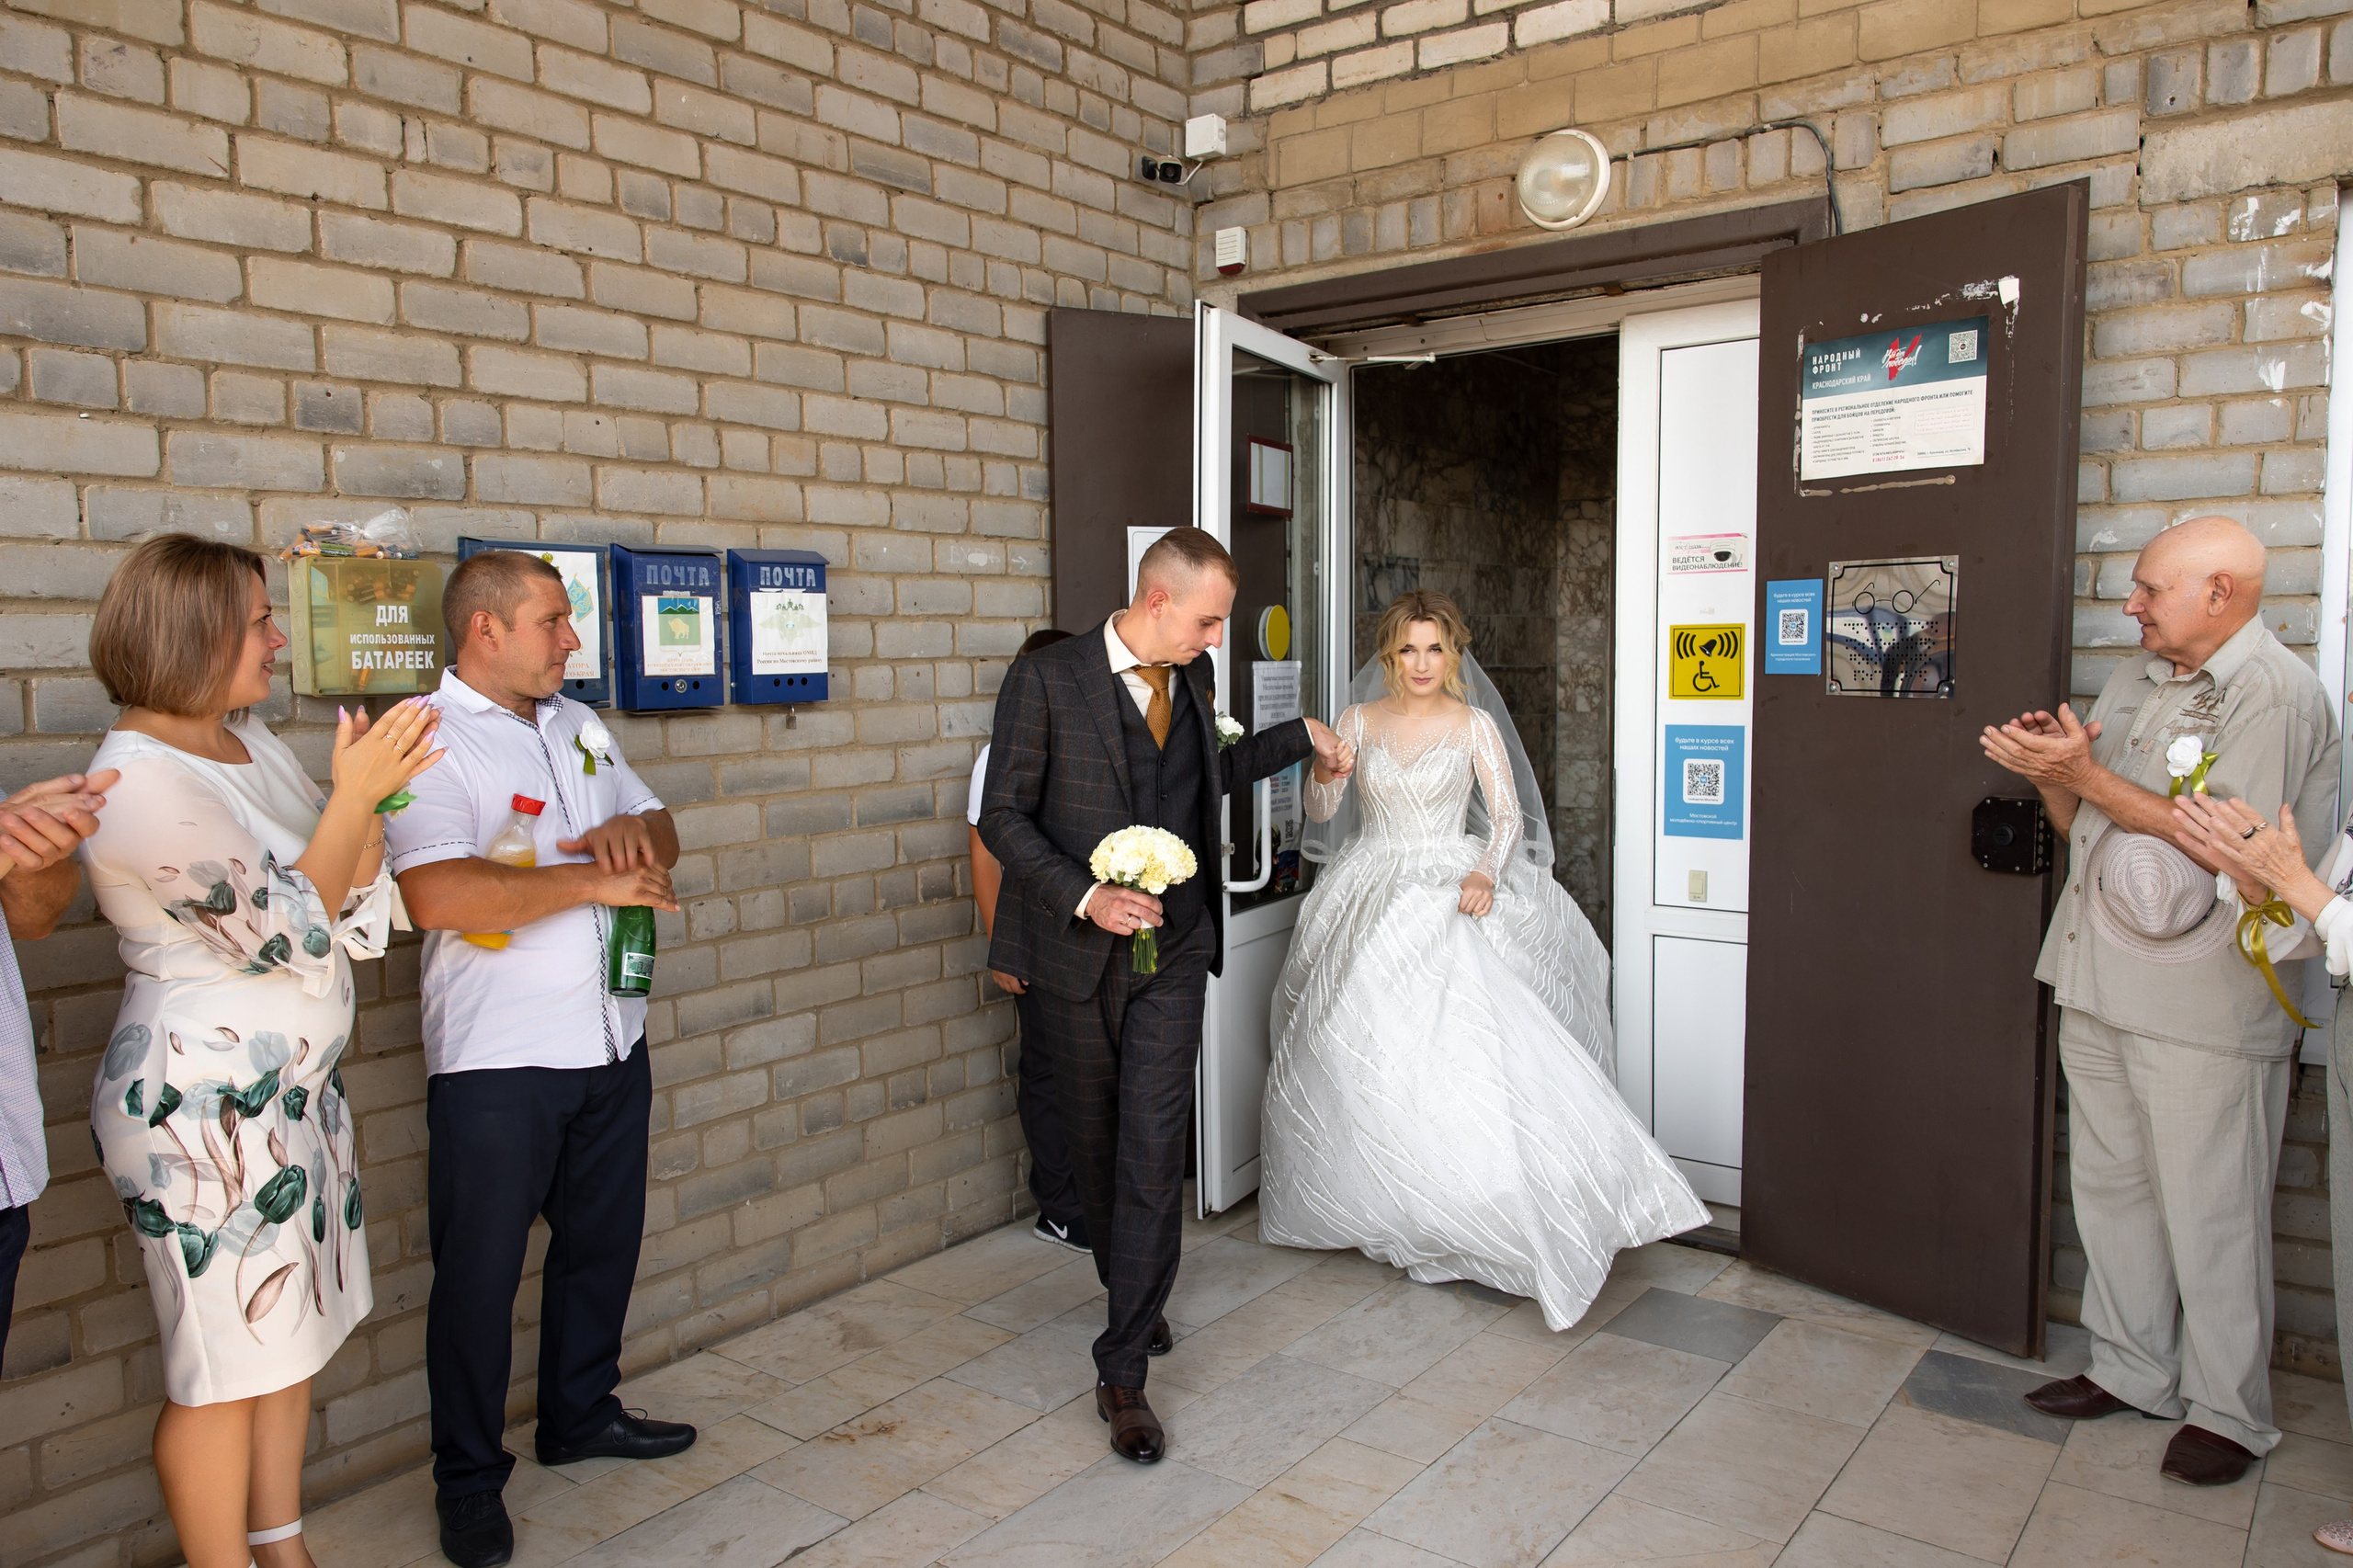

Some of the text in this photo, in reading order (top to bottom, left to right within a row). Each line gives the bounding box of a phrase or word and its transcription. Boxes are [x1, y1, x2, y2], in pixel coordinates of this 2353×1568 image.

[1813, 348, 1861, 366] НАРОДНЫЙ
[1813, 363, 1842, 375] ФРОНТ
[1813, 373, 1870, 390] КРАСНОДАРСКИЙ КРАЙ
[1838, 403, 1870, 411] РЕГИОНАЛЬНОЕ
[1673, 562, 1743, 571] ВИДЕОНАБЛЮДЕНИЕ!
[646, 565, 710, 586] ПОЧТА
[760, 566, 816, 586] ПОЧТА
[376, 605, 408, 627] ДЛЯ
[350, 633, 436, 645] ИСПОЛЬЗОВАННЫХ
[351, 651, 435, 669] БАТАРЕЕК
